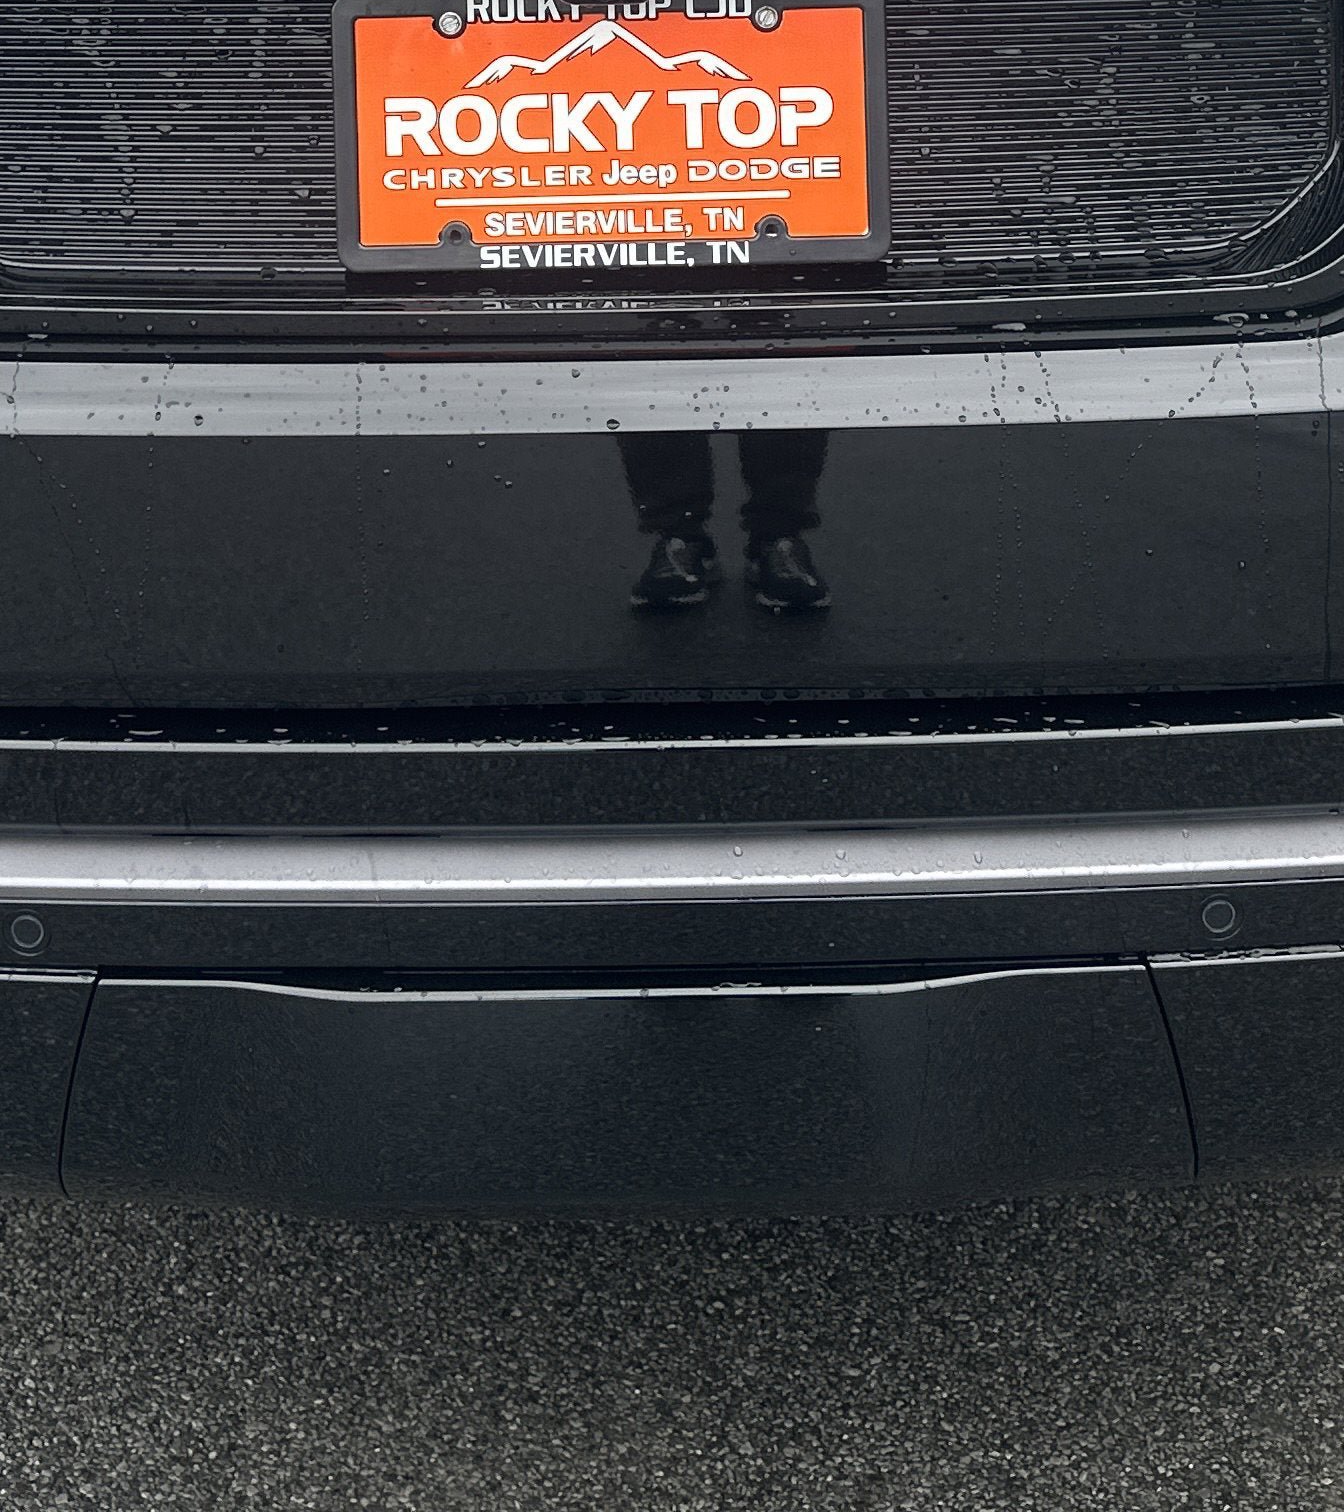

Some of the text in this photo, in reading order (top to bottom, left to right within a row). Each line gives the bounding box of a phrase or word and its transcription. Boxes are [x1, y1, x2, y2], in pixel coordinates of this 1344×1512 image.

[384, 86, 835, 158] ROCKY TOP
[382, 156, 841, 192] CHRYSLER Jeep DODGE
[484, 206, 745, 237] SEVIERVILLE, TN
[480, 240, 750, 268] SEVIERVILLE, TN
